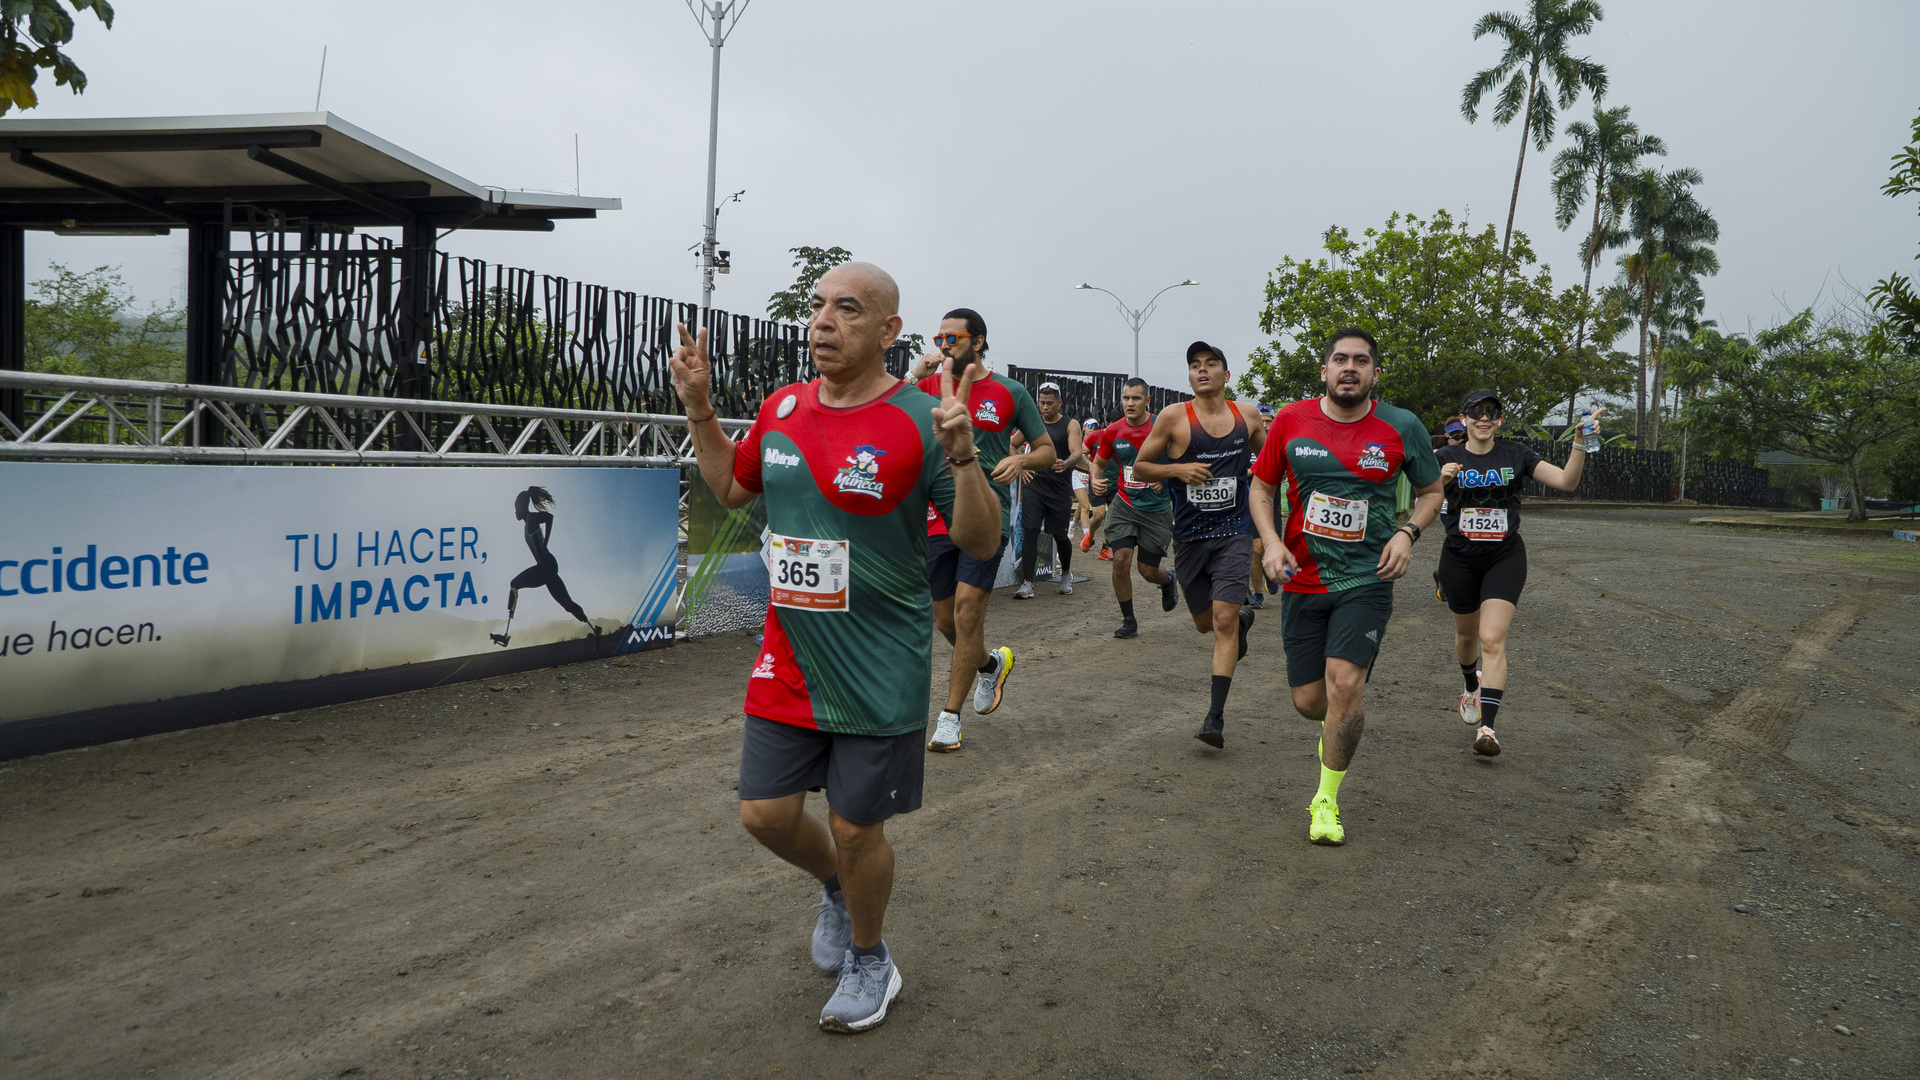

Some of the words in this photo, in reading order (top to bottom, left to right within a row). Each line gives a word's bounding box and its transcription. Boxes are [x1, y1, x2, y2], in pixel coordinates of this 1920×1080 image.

[833, 473, 884, 492] Muñeca
[1195, 488, 1229, 501] 5630
[1320, 508, 1353, 528] 330
[1467, 518, 1499, 530] 1524
[285, 532, 338, 573] TU
[357, 526, 488, 567] HACER,
[778, 559, 820, 588] 365
[1035, 566, 1052, 576] AVAL
[294, 571, 488, 625] IMPACTA.
[47, 620, 162, 652] hacen.
[628, 626, 672, 644] AVAL
